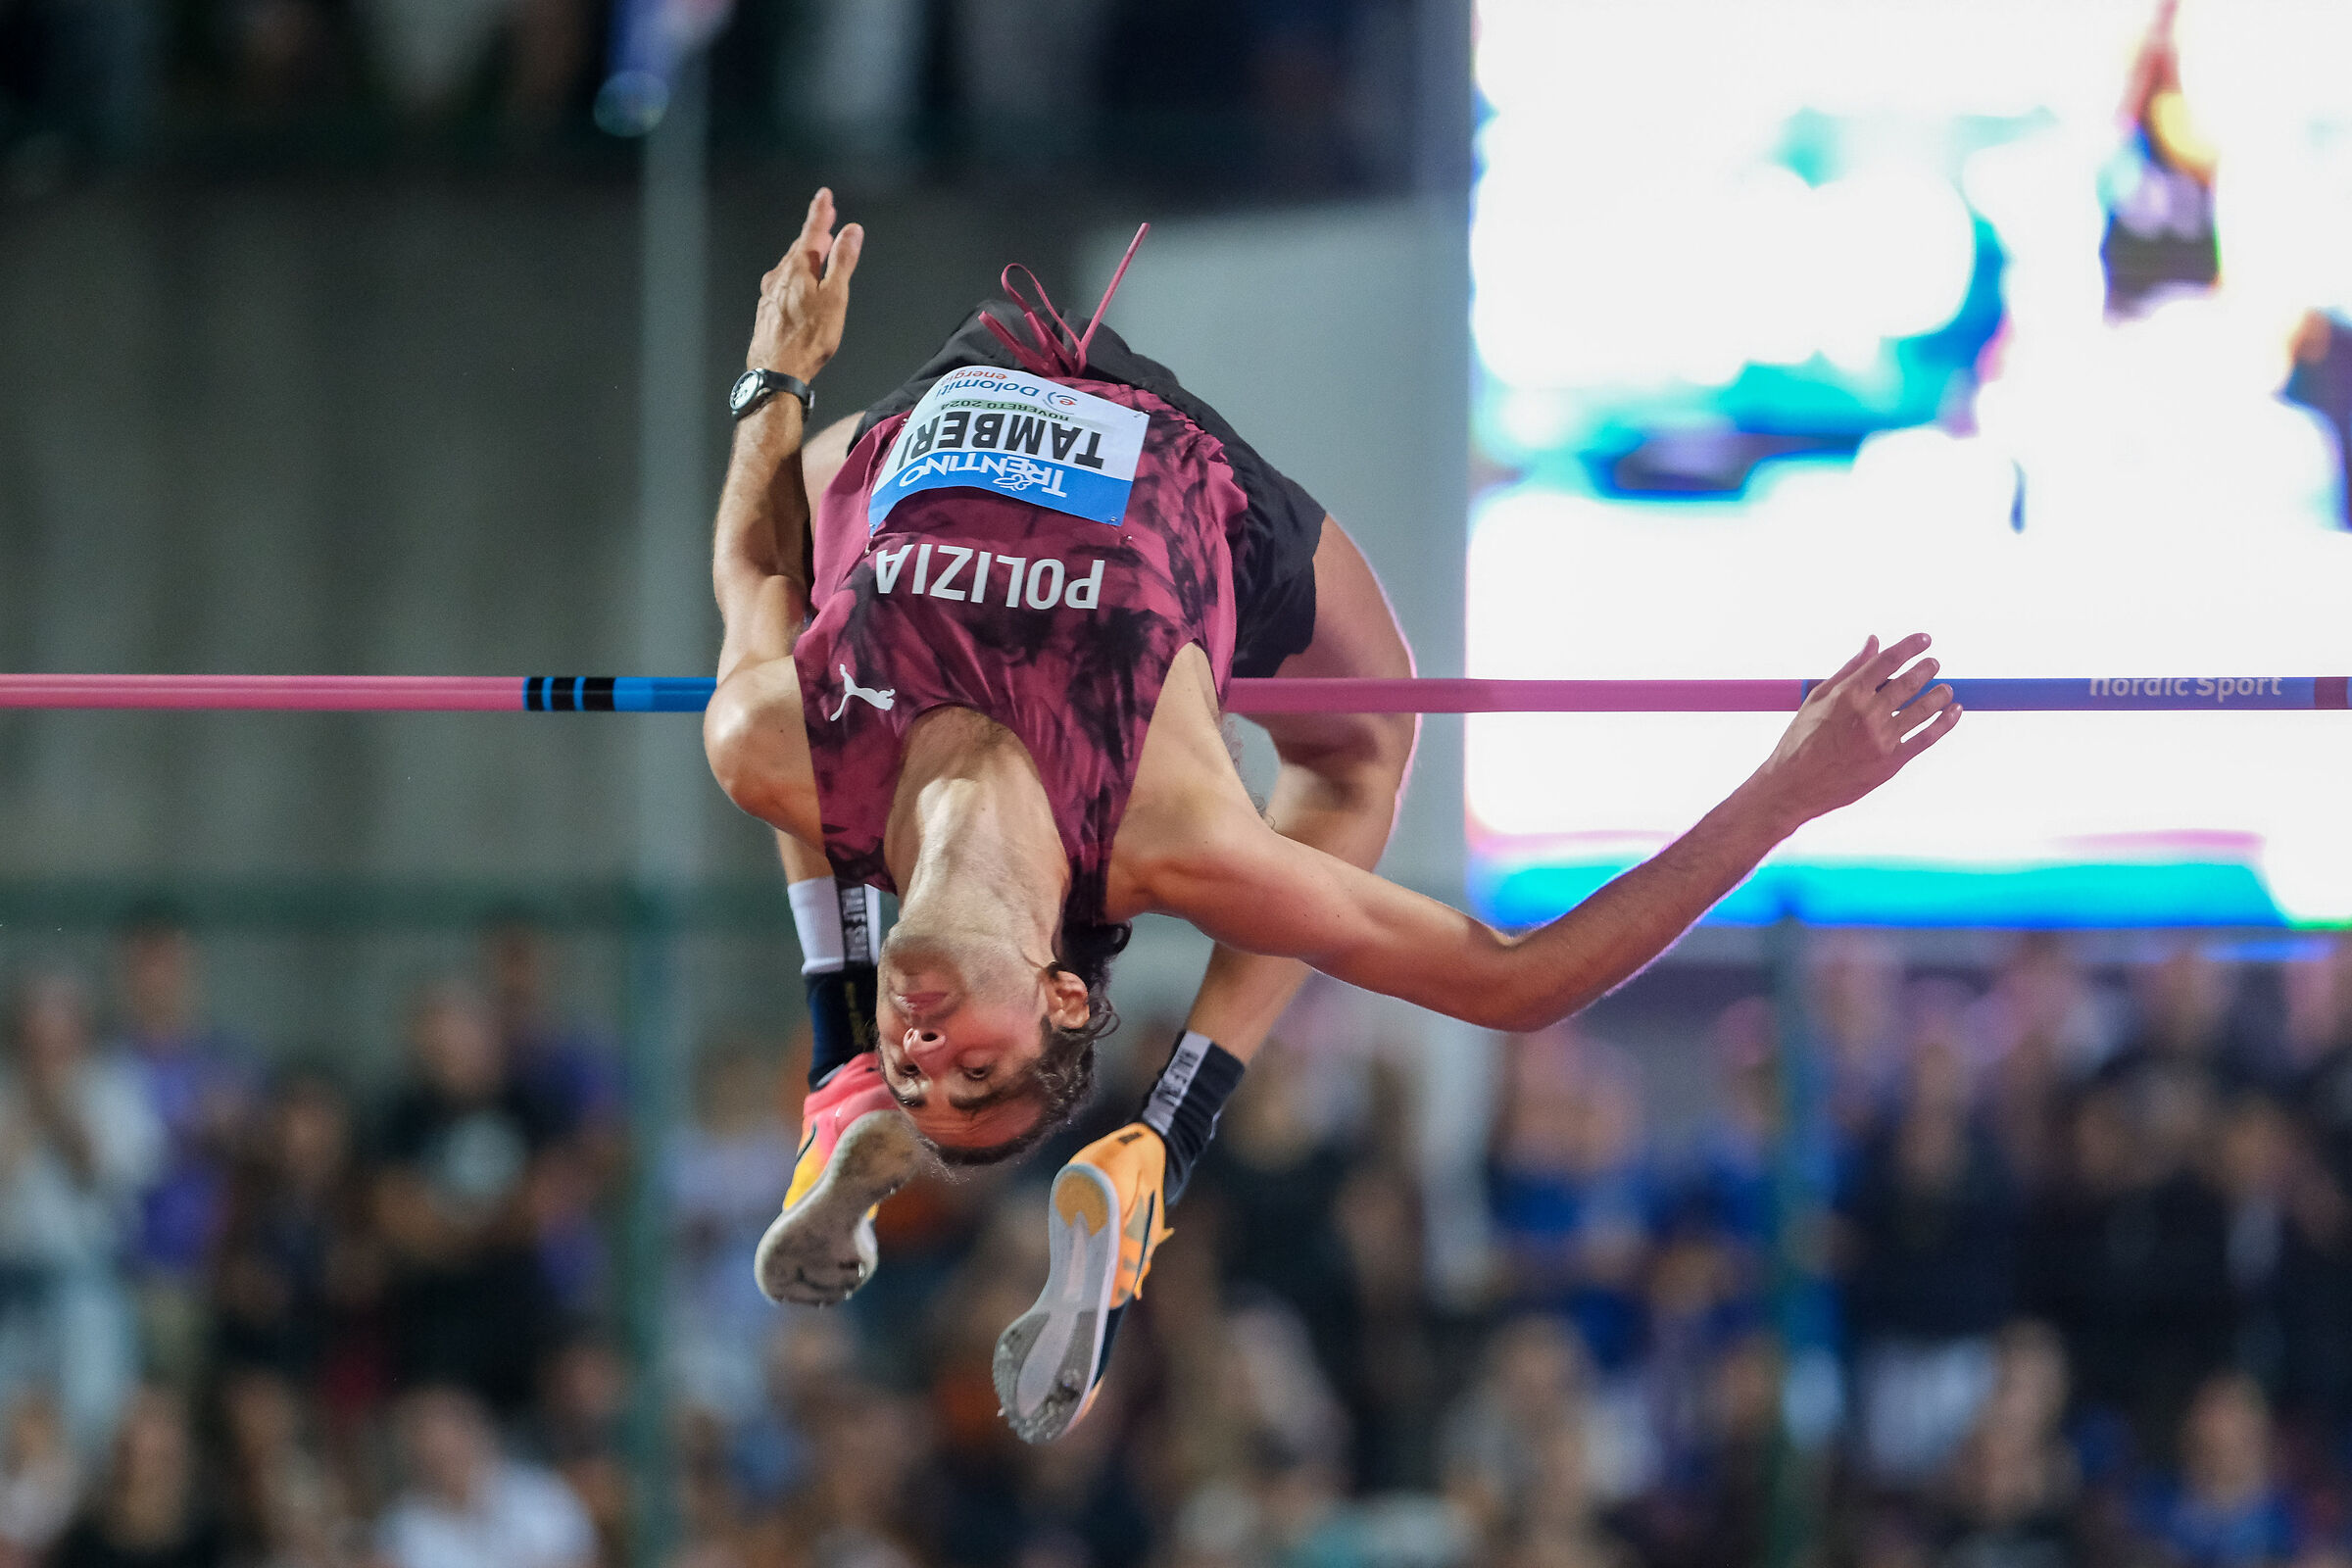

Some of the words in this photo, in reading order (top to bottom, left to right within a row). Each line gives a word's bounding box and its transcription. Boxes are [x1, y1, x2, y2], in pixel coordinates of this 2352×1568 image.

[935, 378, 1041, 401] Dolomiti
[941, 399, 982, 411] 2024
[987, 402, 1069, 421] ROVERETO
[897, 411, 1105, 470] TAMBERI
[899, 451, 1067, 499] TRENTINO
[875, 543, 1105, 611] POLIZIA
